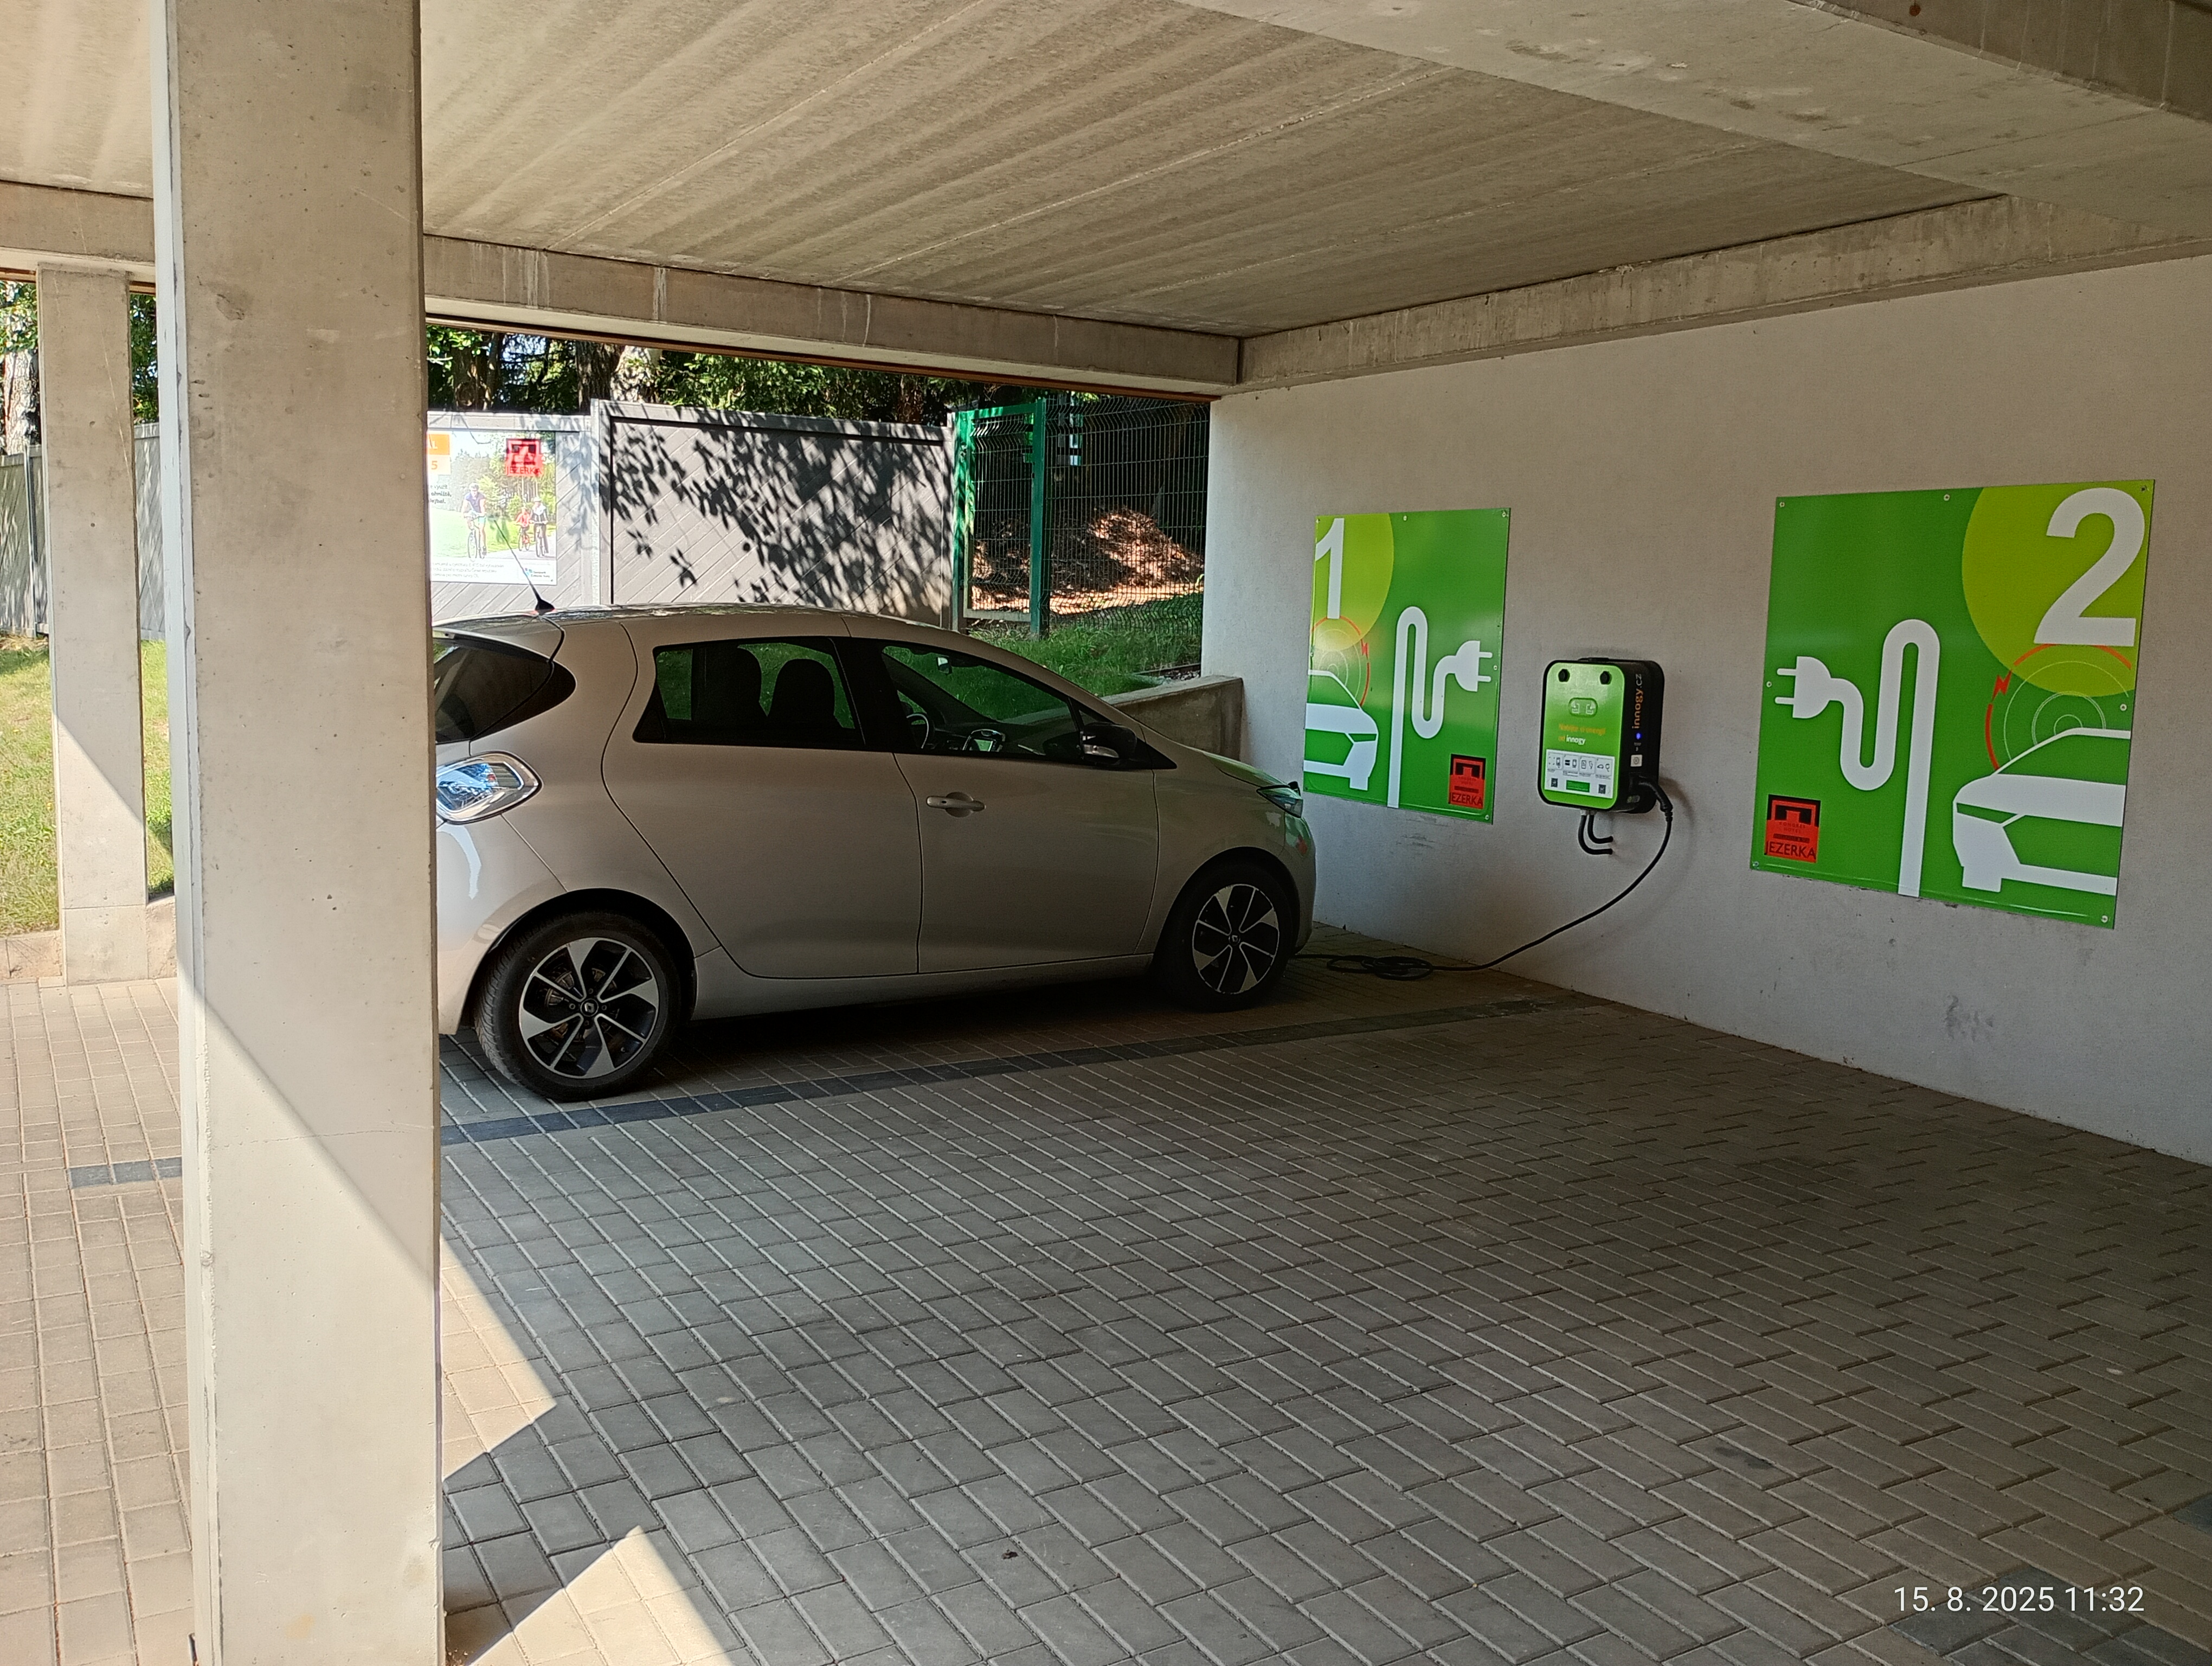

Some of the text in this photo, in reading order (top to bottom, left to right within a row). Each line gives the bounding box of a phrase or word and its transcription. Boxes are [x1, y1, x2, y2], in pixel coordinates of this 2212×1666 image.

[507, 466, 542, 476] JEZERKA
[1315, 518, 1345, 619] 1
[2033, 486, 2145, 647] 2
[1631, 674, 1643, 729] innogy.cz
[1566, 734, 1586, 745] innogy
[1448, 792, 1483, 807] JEZERKA
[1764, 841, 1816, 860] JEZERKA
